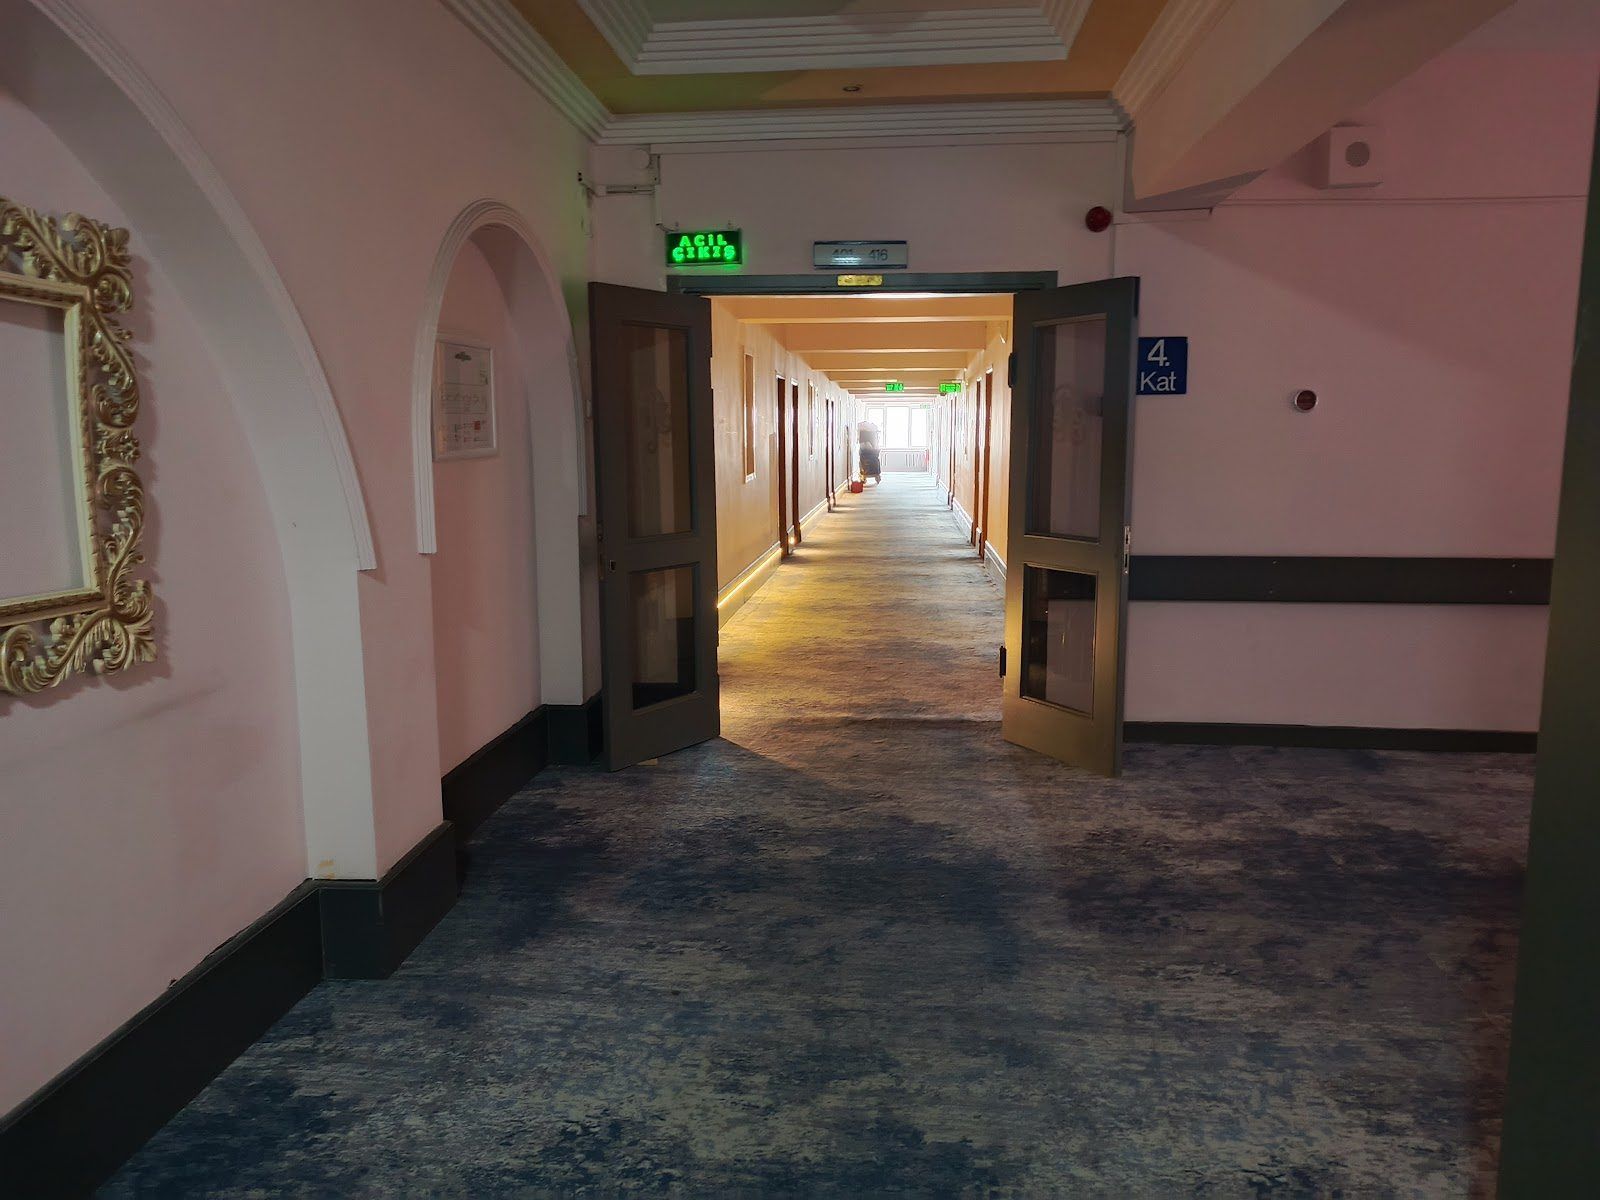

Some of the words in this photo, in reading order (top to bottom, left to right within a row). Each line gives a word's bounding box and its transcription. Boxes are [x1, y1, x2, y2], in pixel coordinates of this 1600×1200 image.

[869, 248, 889, 261] 416
[1147, 339, 1170, 367] 4.
[1140, 371, 1177, 391] Kat
